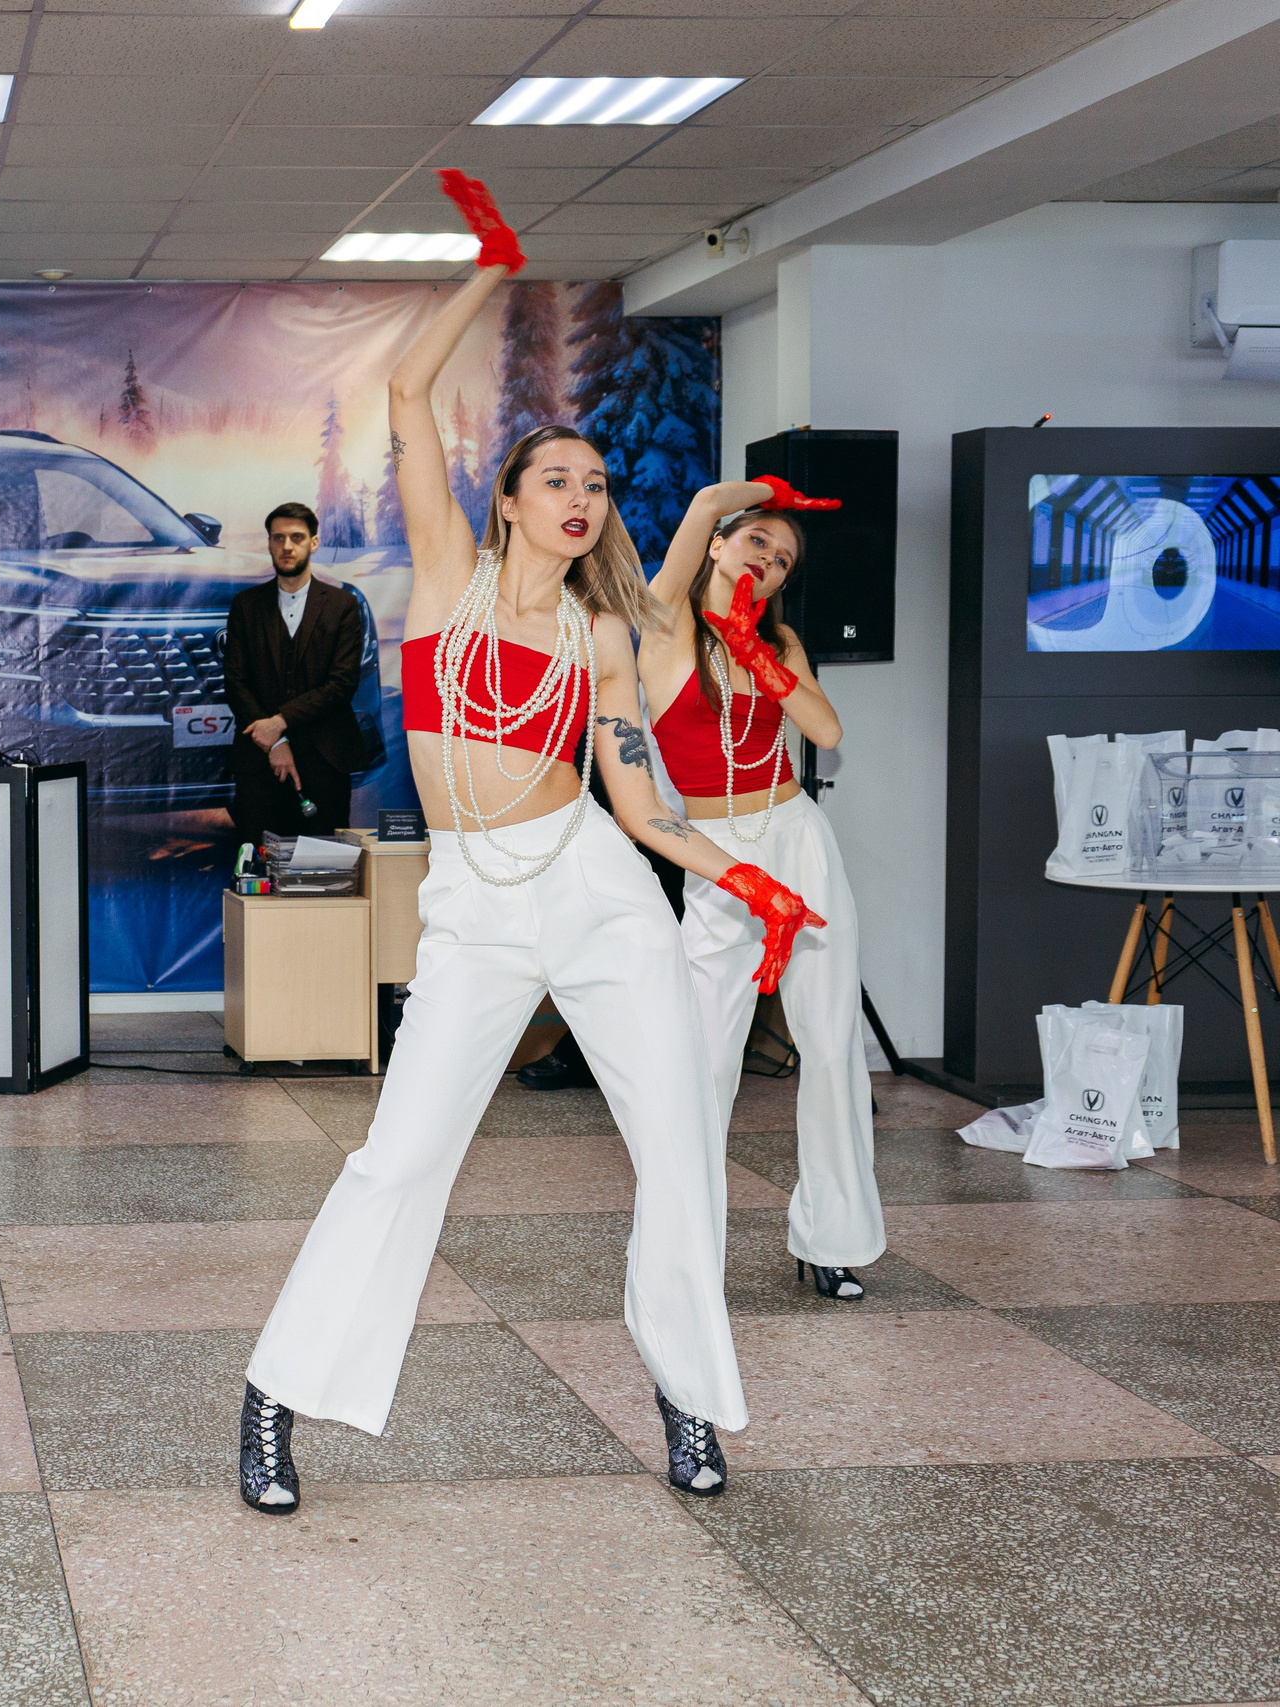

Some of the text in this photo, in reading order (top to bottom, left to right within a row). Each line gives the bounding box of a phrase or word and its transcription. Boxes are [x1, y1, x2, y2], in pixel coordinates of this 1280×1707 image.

[187, 716, 234, 735] CS7
[1211, 825, 1244, 833] Агат-А
[1069, 1113, 1118, 1128] CHANGAN
[1064, 1126, 1116, 1142] Агат-Авто
